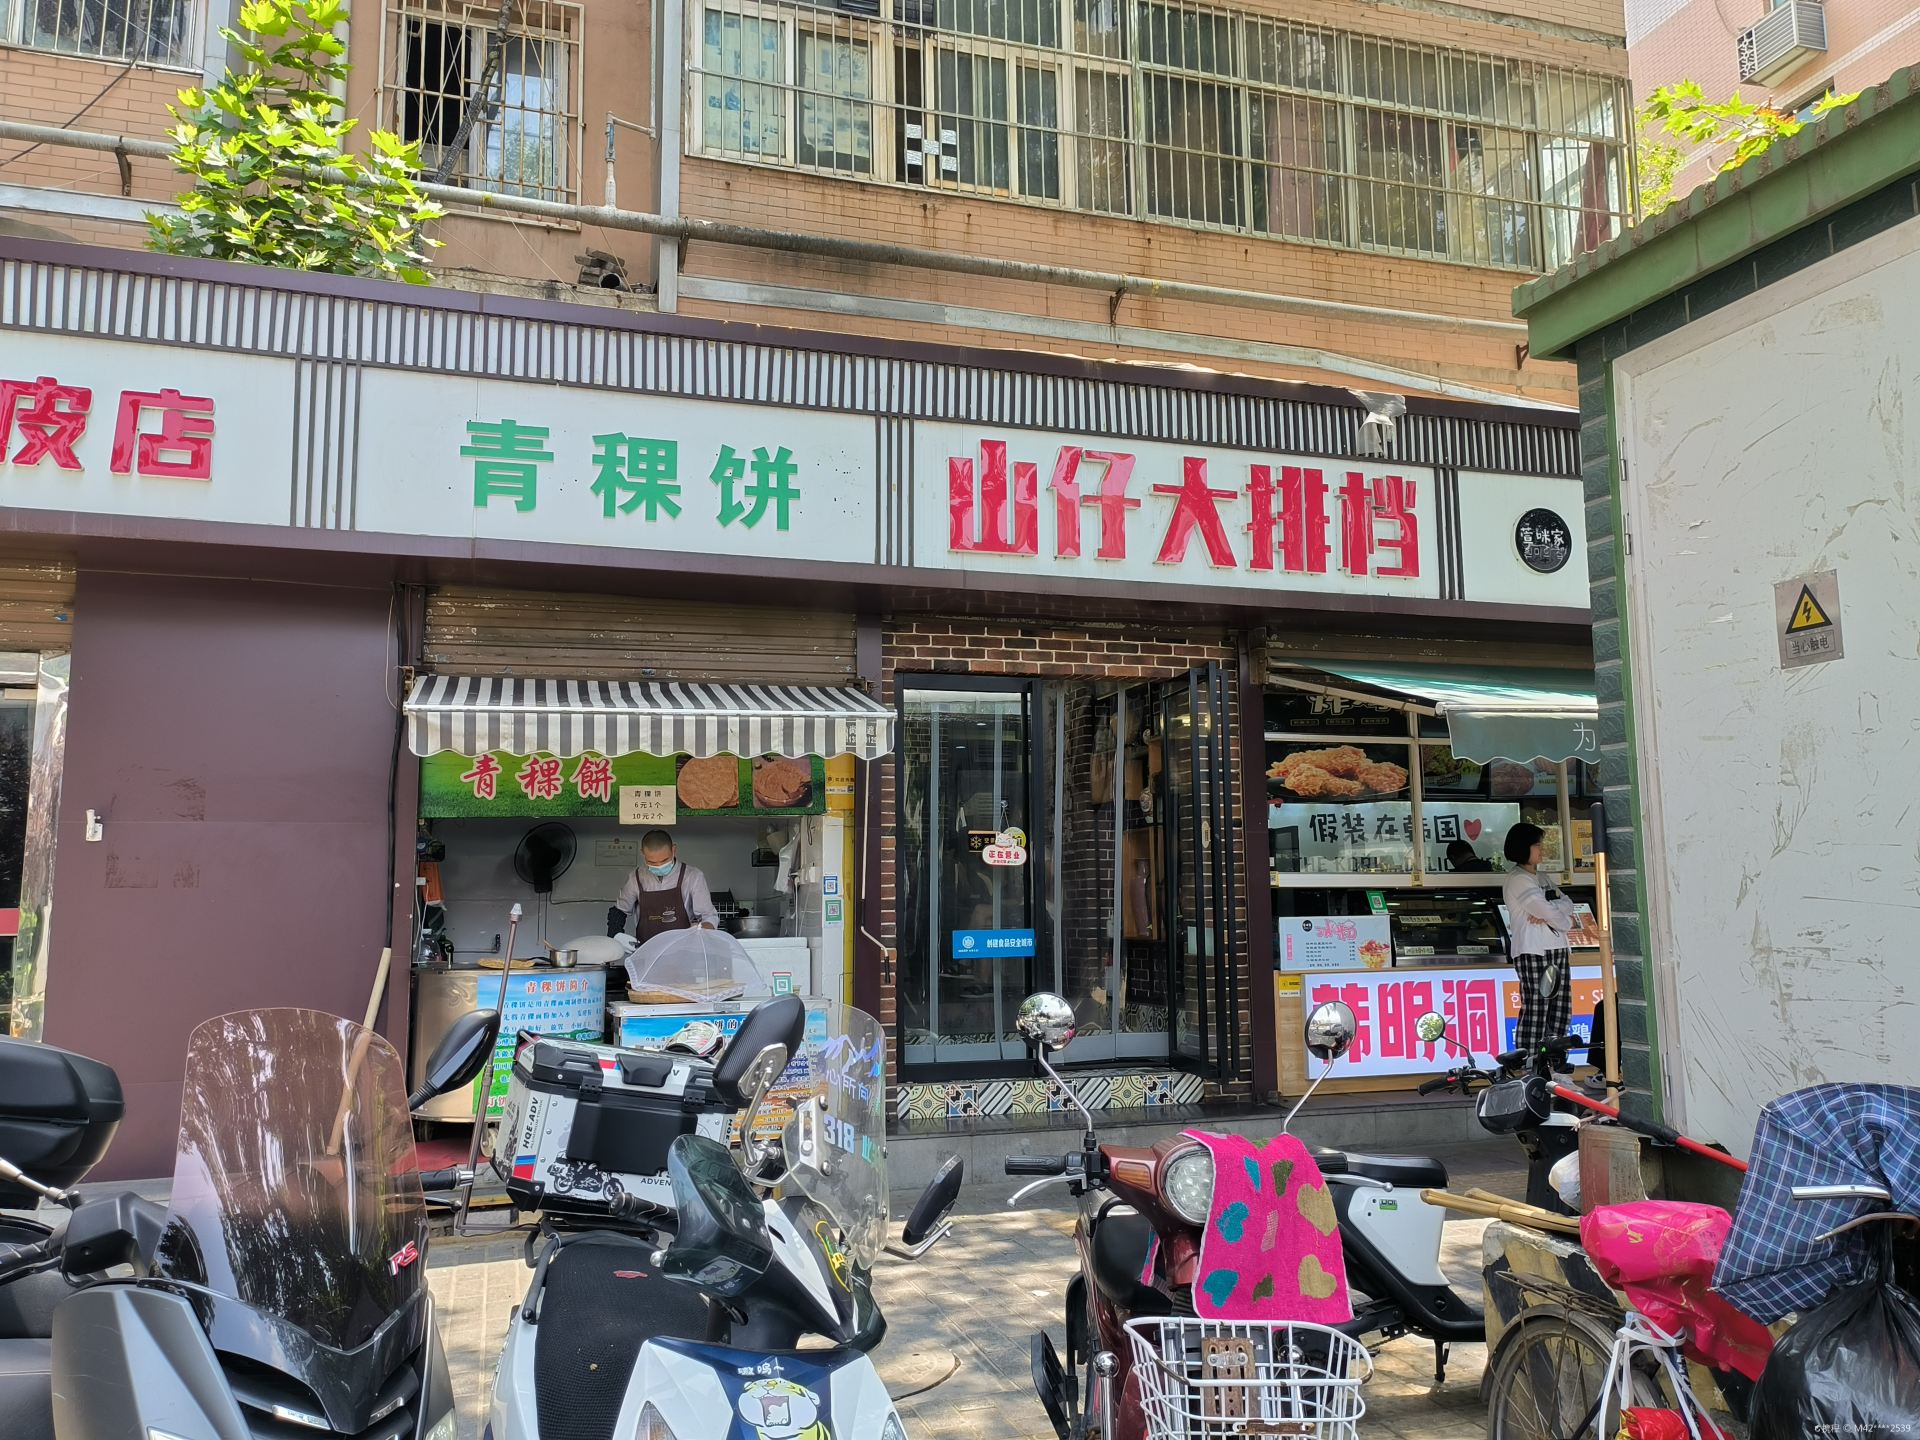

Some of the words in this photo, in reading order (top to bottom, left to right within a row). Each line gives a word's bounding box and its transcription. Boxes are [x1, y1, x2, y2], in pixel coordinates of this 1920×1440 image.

[460, 418, 801, 532] 青稞饼
[948, 438, 1420, 580] 山仔大排档
[1791, 635, 1830, 655] 当心触电
[1572, 721, 1596, 751] 为
[1309, 813, 1461, 844] 假装在韩国
[522, 1096, 539, 1149] HQE-ADV
[823, 1113, 856, 1153] 318
[640, 1177, 672, 1187] ADVEN
[387, 1240, 419, 1276] RS
